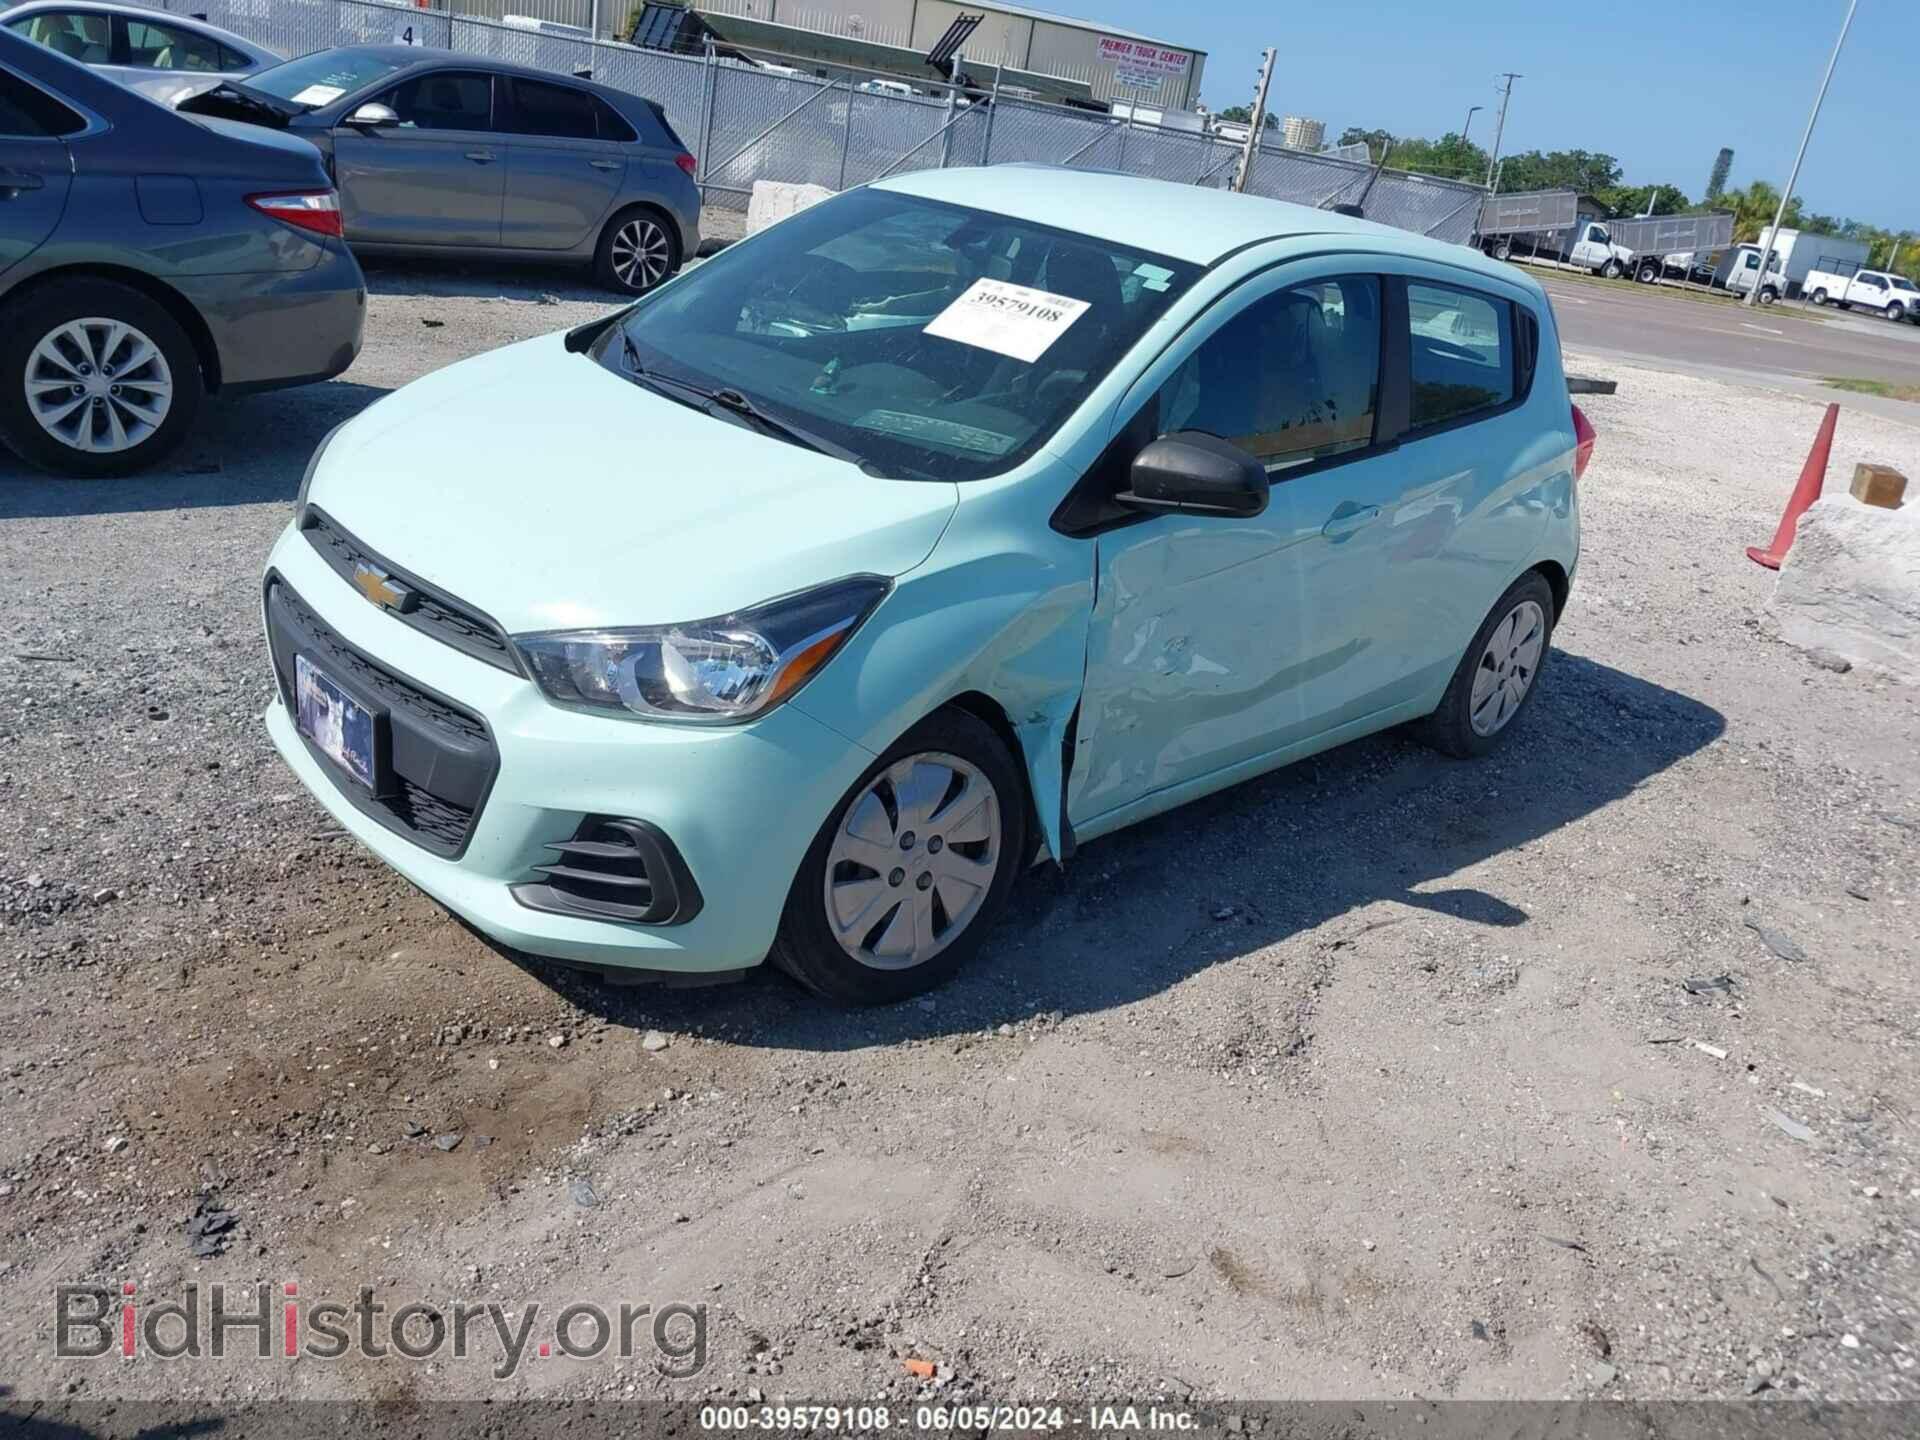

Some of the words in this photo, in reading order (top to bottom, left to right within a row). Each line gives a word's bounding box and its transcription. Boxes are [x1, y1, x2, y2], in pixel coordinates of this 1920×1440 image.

[402, 26, 414, 46] 4
[1100, 38, 1132, 53] PREMIER
[1135, 45, 1158, 58] TRUCK
[1160, 50, 1188, 65] CENTER
[970, 291, 1063, 323] 39579108
